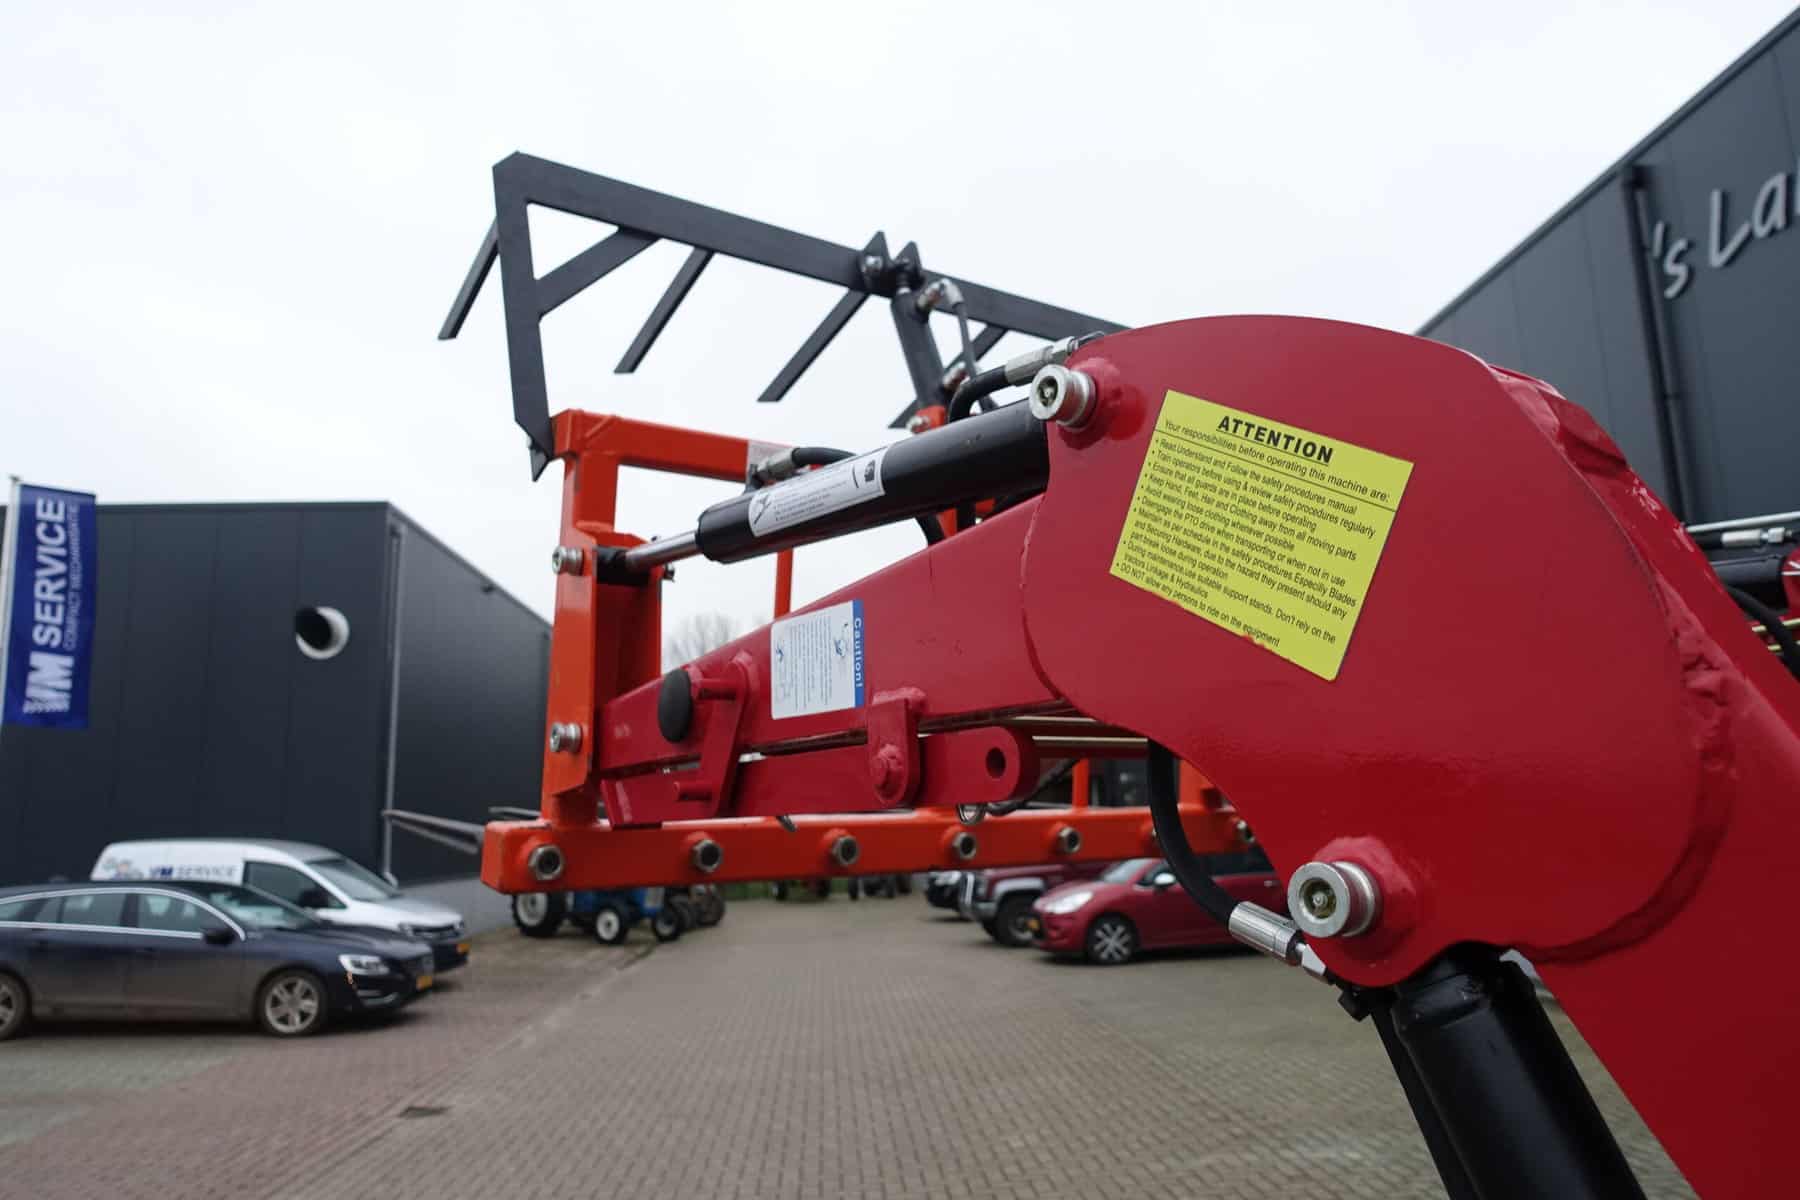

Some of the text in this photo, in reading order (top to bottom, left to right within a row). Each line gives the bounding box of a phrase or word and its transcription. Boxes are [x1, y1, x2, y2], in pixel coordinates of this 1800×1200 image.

[1709, 155, 1800, 268] La
[1164, 420, 1390, 502] Your responsibilities before operating this machine are:
[1218, 414, 1333, 463] ATTENTION
[1152, 462, 1318, 532] Ensure that all guards are in place before operating
[1156, 451, 1376, 539] Train operators before using & review safety procedures regularly
[1161, 492, 1186, 509] wearing
[1186, 501, 1204, 515] loose
[1203, 508, 1230, 527] clothing
[1230, 519, 1264, 539] whenever
[1263, 532, 1295, 553] possible
[1212, 457, 1226, 468] and
[1226, 462, 1249, 477] Follow
[1248, 470, 1261, 481] the
[1260, 474, 1283, 491] safety
[1283, 482, 1327, 506] procedures
[1327, 497, 1357, 515] manual
[1129, 530, 1229, 582] part break loose during operation
[1134, 518, 1146, 530] and
[1145, 523, 1172, 543] Securing
[1203, 548, 1217, 561] due
[1216, 554, 1225, 564] to
[1224, 557, 1237, 569] the
[1236, 562, 1261, 580] hazard
[1260, 573, 1276, 589] they
[1276, 580, 1306, 601] present
[1305, 592, 1332, 611] should
[1330, 605, 1347, 620] any
[1137, 507, 1163, 524] Maintain
[1163, 519, 1171, 528] as
[1170, 523, 1182, 534] per
[1182, 526, 1211, 545] schedule
[1211, 538, 1219, 548] in
[1219, 541, 1231, 553] the
[1230, 546, 1252, 564] safety
[1251, 555, 1293, 582] procedures
[1328, 587, 1357, 606] Blades
[1140, 496, 1346, 586] Disengage the PTO drive when transporting or when not in use
[1200, 493, 1216, 505] Hair
[1215, 499, 1229, 510] and
[1228, 504, 1258, 524] Clothing
[1257, 517, 1276, 531] away
[1277, 523, 1296, 537] from
[1296, 530, 1306, 540] all
[1305, 534, 1335, 554] moving
[1334, 545, 1358, 563] parts
[32, 498, 67, 648] SERVICE
[1120, 563, 1280, 648] DO NOT allow any persons to ride on the equipment
[1126, 541, 1146, 558] During
[1196, 573, 1222, 591] suitable
[1221, 584, 1248, 605] support
[1294, 618, 1310, 633] rely
[1310, 626, 1322, 637] on
[1321, 630, 1337, 643] the
[1144, 562, 1169, 581] Linkage
[1169, 573, 1175, 582] &
[1174, 576, 1209, 600] Hydraulics
[854, 617, 863, 688] Caution!
